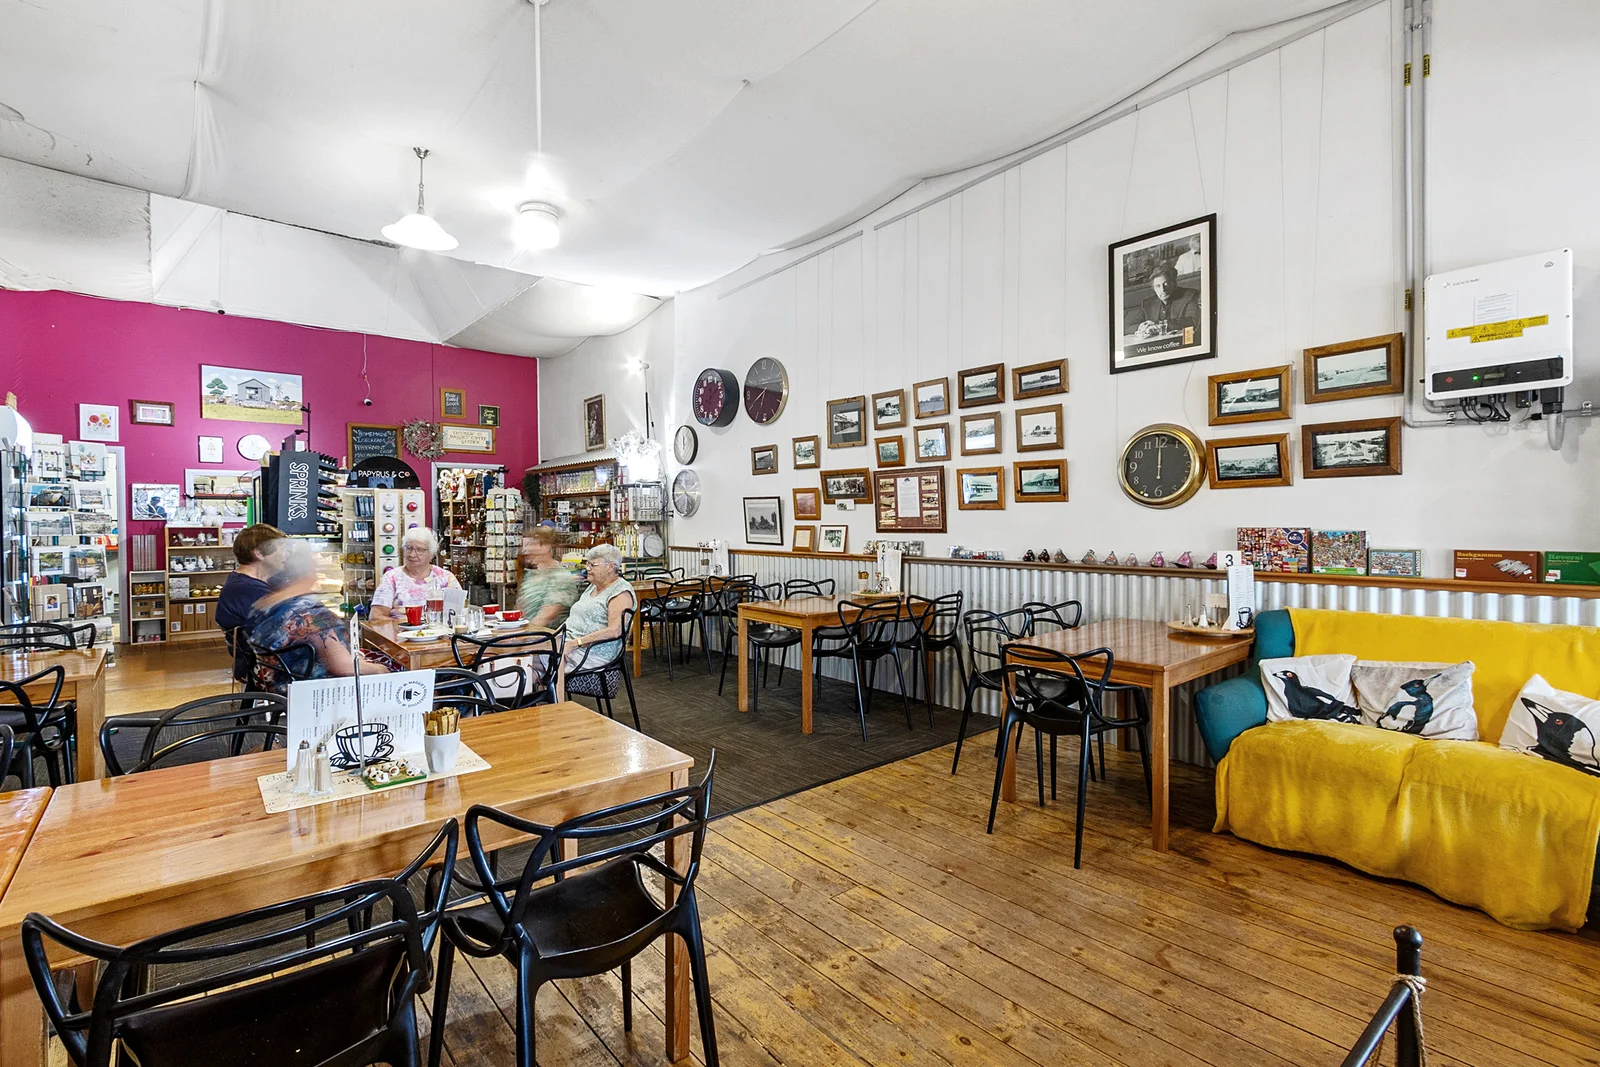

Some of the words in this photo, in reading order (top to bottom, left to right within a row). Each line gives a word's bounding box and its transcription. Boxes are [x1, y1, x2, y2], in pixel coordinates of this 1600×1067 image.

[1144, 442, 1152, 450] 11
[1155, 436, 1168, 448] 12
[1134, 450, 1144, 458] 10
[1129, 462, 1138, 473] 9
[1154, 486, 1162, 497] 6
[882, 544, 886, 553] 2
[1226, 554, 1234, 567] 3
